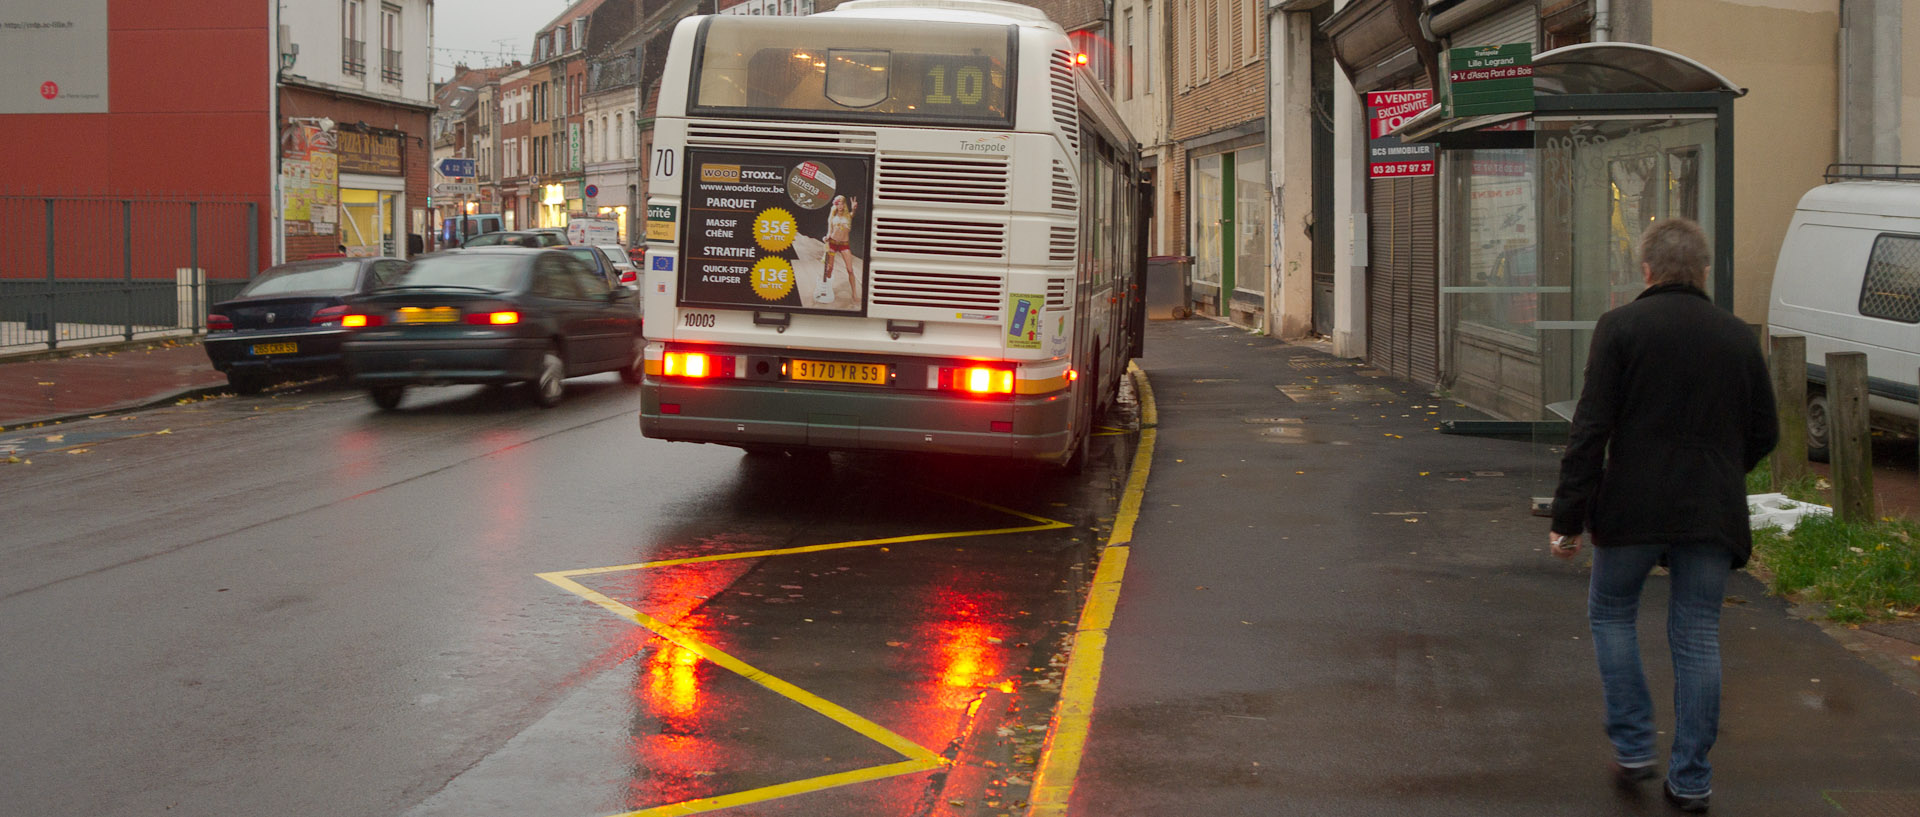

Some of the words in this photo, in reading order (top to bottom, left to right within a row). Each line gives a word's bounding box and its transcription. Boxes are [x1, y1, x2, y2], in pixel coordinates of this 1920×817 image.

[1485, 57, 1514, 66] Legrand
[1467, 71, 1489, 79] d'Ascq
[1507, 68, 1516, 76] de
[1518, 67, 1532, 75] Bois
[926, 64, 983, 104] 10
[44, 86, 55, 94] 31
[1375, 94, 1383, 104] A
[960, 140, 1006, 152] Transpole
[1372, 148, 1387, 156] BCS
[1388, 146, 1430, 155] IMMOBILIER
[656, 149, 674, 176] 70
[704, 169, 738, 178] WOOD
[1373, 166, 1384, 174] 03
[1385, 165, 1395, 173] 20
[1397, 164, 1407, 172] 57
[1409, 164, 1419, 172] 97
[1421, 164, 1431, 172] 37
[700, 184, 784, 194] www.woodstoxx.be
[706, 198, 756, 208] PARQUET
[706, 219, 737, 227] MASSIF
[760, 220, 790, 234] 35€
[705, 228, 734, 238] CHÊNE
[703, 246, 755, 258] STRATIFIÉ
[703, 265, 748, 273] QUICK-STEP
[709, 276, 740, 284] CLIPSER
[758, 268, 788, 282] 13€
[684, 313, 715, 328] 10003
[801, 362, 835, 378] 9170
[840, 364, 856, 380] YR
[862, 366, 878, 381] 59
